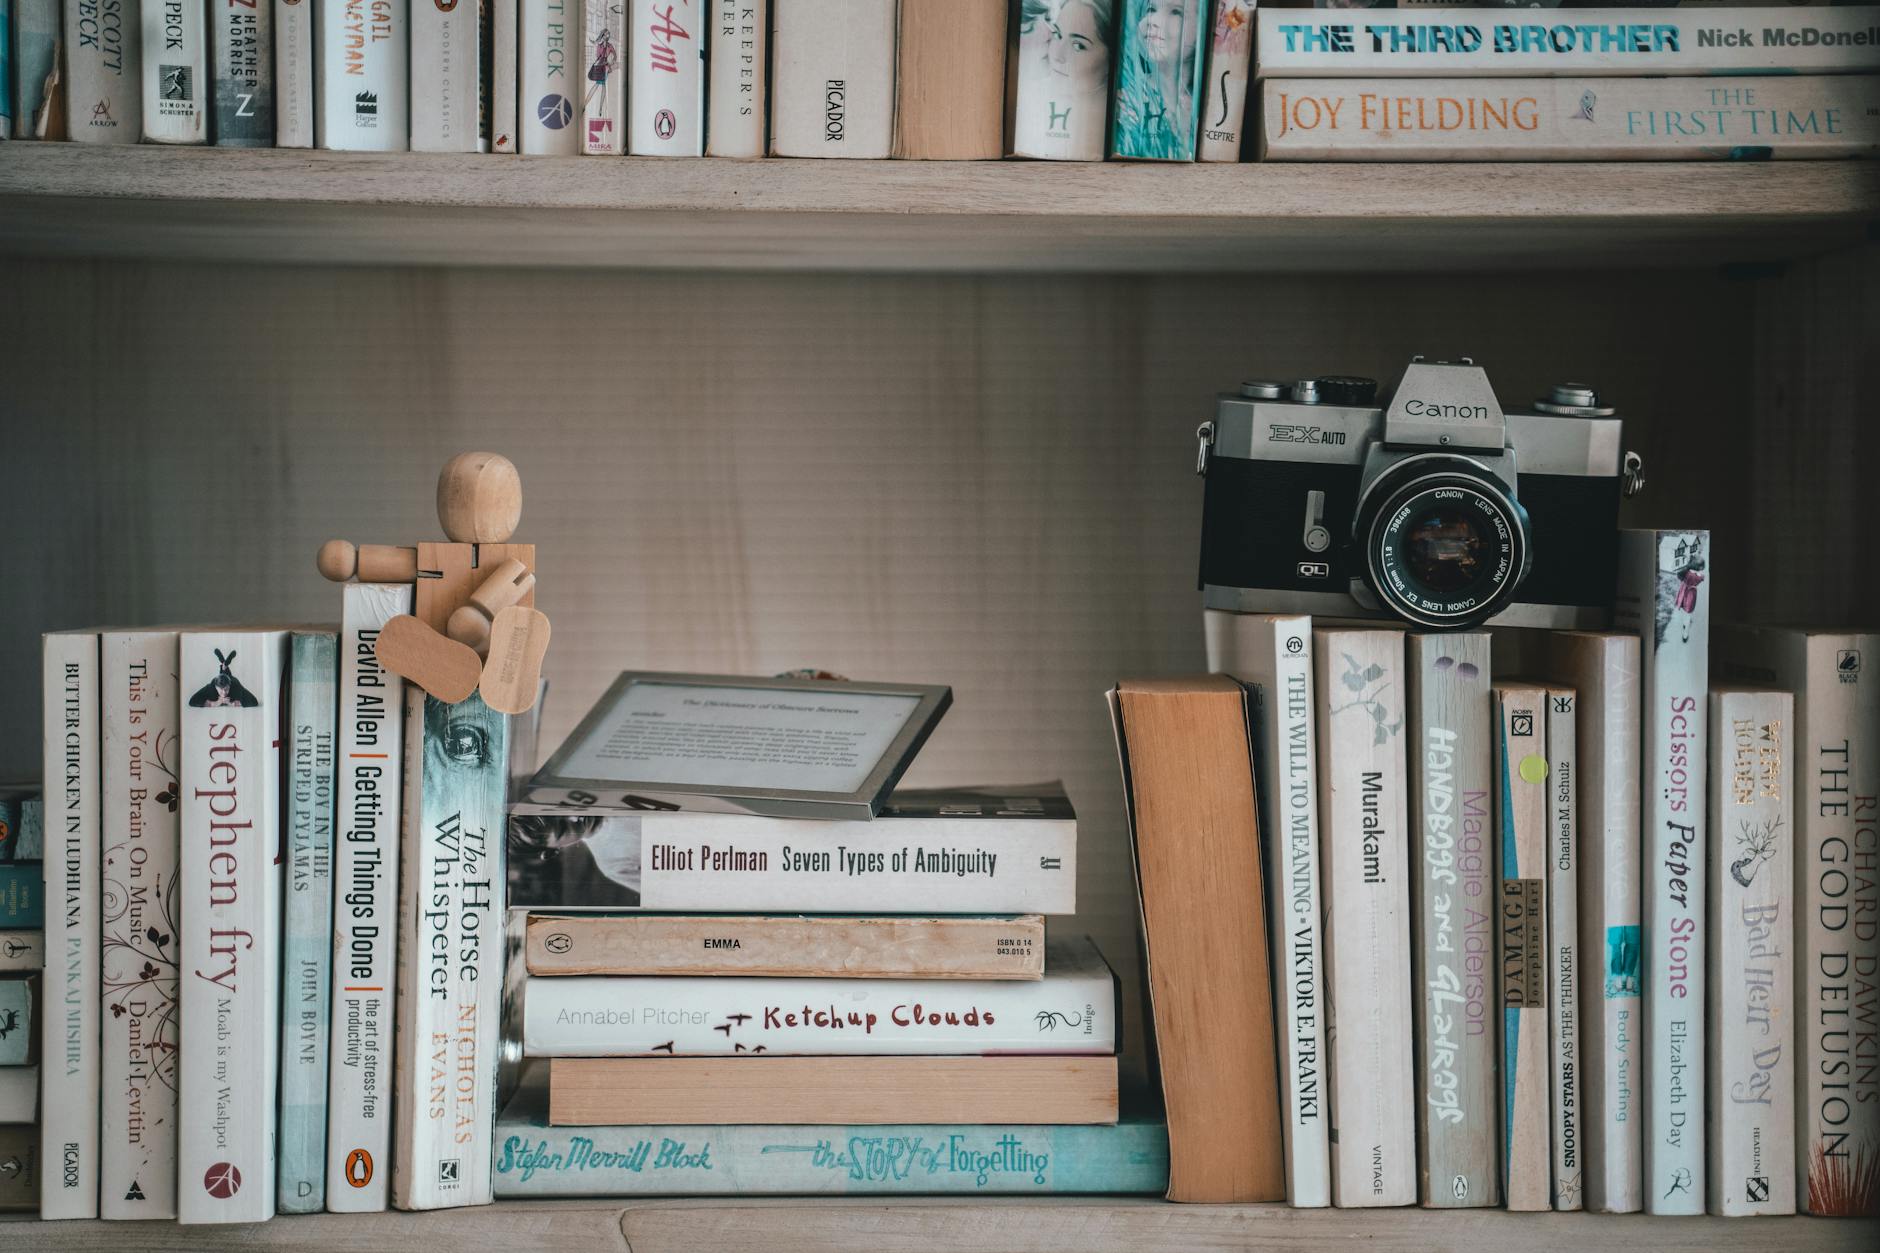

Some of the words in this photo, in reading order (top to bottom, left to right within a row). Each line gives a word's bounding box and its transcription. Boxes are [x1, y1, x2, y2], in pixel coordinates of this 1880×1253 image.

[102, 0, 122, 75] SCOTT
[165, 2, 183, 50] PECK
[229, 14, 243, 76] MORRIS
[244, 15, 257, 88] HEATHER
[442, 21, 450, 73] MODERN
[547, 23, 564, 79] PECK
[650, 4, 690, 74] Am
[1278, 24, 1355, 54] THE
[1364, 24, 1483, 54] THIRD
[1492, 24, 1681, 54] BROTHER
[1697, 28, 1754, 48] Nick
[740, 9, 754, 116] KEEPER'S
[159, 101, 186, 109] SIMON
[235, 93, 255, 117] Z
[355, 114, 377, 122] Harper
[442, 80, 450, 139] CLASSICS
[826, 80, 845, 142] PICADOR
[1277, 92, 1345, 139] JOY
[1358, 93, 1540, 132] FIELDING
[1626, 110, 1732, 136] FIRST
[1741, 108, 1843, 135] TIME
[1706, 87, 1755, 106] THE
[1268, 424, 1321, 445] EX
[1321, 430, 1347, 446] AUTO
[1404, 399, 1489, 420] Canon
[1434, 490, 1465, 500] CANON
[1474, 498, 1495, 516] LENS
[1491, 516, 1509, 541] MADE
[1501, 543, 1510, 553] IN
[1300, 565, 1326, 577] QL
[1492, 556, 1509, 584] JAPAN
[1406, 591, 1419, 603] EX
[1421, 599, 1444, 612] LENS
[1446, 597, 1476, 612] CANON
[129, 659, 148, 703] This
[356, 629, 385, 687] David
[65, 663, 80, 730] BUTTER
[129, 708, 147, 724] Is
[356, 694, 385, 747] Allen
[1288, 672, 1307, 718] THE
[65, 732, 81, 811] CHICKEN
[129, 731, 148, 781] Your
[295, 725, 313, 803] STRIPED
[315, 732, 332, 768] THE
[1288, 722, 1308, 778] WILL
[1668, 696, 1697, 813] Scissors
[315, 775, 331, 809] BOY
[346, 765, 383, 843] Getting
[1290, 779, 1308, 809] TO
[1558, 761, 1571, 803] Schulz
[1819, 739, 1850, 818] THE
[66, 815, 81, 833] IN
[129, 788, 148, 840] Brain
[195, 722, 254, 909] stephen
[314, 816, 330, 835] IN
[1362, 771, 1386, 884] Murakami
[1558, 804, 1572, 822] M.
[129, 846, 148, 879] On
[294, 810, 312, 892] PYJAMAS
[313, 841, 330, 879] THE
[463, 828, 487, 874] The
[652, 844, 694, 872] Elliot
[701, 845, 768, 872] Perlman
[782, 846, 831, 872] Seven
[837, 846, 885, 877] Types
[892, 847, 909, 873] of
[914, 847, 998, 878] Ambiguity
[1291, 814, 1313, 914] MEANING
[1457, 789, 1490, 898] Maggie
[1558, 823, 1571, 871] Charles
[1664, 819, 1697, 909] Paper
[1854, 795, 1880, 943] RICHARD
[66, 838, 81, 929] LUDHIANA
[345, 847, 382, 918] Things
[424, 810, 461, 1000] Whisperer
[1528, 880, 1539, 917] Hart
[1819, 837, 1850, 932] GOD
[129, 886, 148, 945] Music
[460, 877, 491, 983] Horse
[1741, 893, 1782, 961] Bad
[65, 937, 82, 1004] PANKAJ
[196, 926, 254, 993] fry
[351, 926, 379, 979] Done
[703, 939, 741, 949] EMMA
[1294, 926, 1314, 1010] VIKTOR
[1503, 881, 1524, 1008] DAMAGE
[1528, 925, 1542, 1006] Josephine
[1669, 917, 1697, 1000] Stone
[301, 960, 318, 1002] JOHN
[1463, 908, 1490, 1038] Alderson
[1560, 946, 1573, 1009] THINKER
[216, 998, 231, 1041] Moab
[364, 998, 380, 1017] the
[556, 1007, 636, 1026] Annabel
[642, 1007, 710, 1026] Pitcher
[764, 1005, 878, 1035] Ketchup
[891, 1004, 996, 1027] Clouds
[1083, 1004, 1096, 1035] Indigo
[1296, 1014, 1316, 1032] E.
[1561, 1011, 1573, 1040] THE
[1743, 967, 1777, 1036] Heir
[65, 1009, 82, 1077] MISHRA
[129, 1000, 149, 1066] Daniel
[216, 1046, 231, 1056] is
[299, 1010, 317, 1064] BOYNE
[344, 999, 362, 1068] productivity
[363, 1040, 379, 1051] of
[364, 1020, 379, 1037] art
[1561, 1043, 1574, 1061] AS
[1615, 1009, 1632, 1054] Body
[1854, 955, 1880, 1105] DAWKINS
[212, 1061, 229, 1082] my
[430, 1032, 449, 1120] EVANS
[455, 1003, 477, 1144] NICHOLAS
[1298, 1034, 1319, 1124] FRANKL
[1669, 1019, 1687, 1104] Elizabeth
[1730, 1038, 1782, 1108] Day
[1819, 951, 1852, 1160] DELUSION
[129, 1073, 148, 1144] Levitin
[362, 1055, 379, 1118] stress-free
[1562, 1063, 1574, 1109] STARS
[1614, 1059, 1632, 1122] Surfing
[213, 1086, 231, 1150] Washpot
[1563, 1110, 1576, 1169] SNOOPY
[1666, 1110, 1687, 1148] Day
[64, 1142, 80, 1188] PICADOR
[497, 1134, 563, 1182] Stefan
[565, 1136, 662, 1173] Merrill
[654, 1136, 715, 1172] Block
[948, 1134, 1048, 1189] Forgetting
[1373, 1144, 1383, 1196] VINTAGE
[1752, 1127, 1762, 1175] HEADLINE
